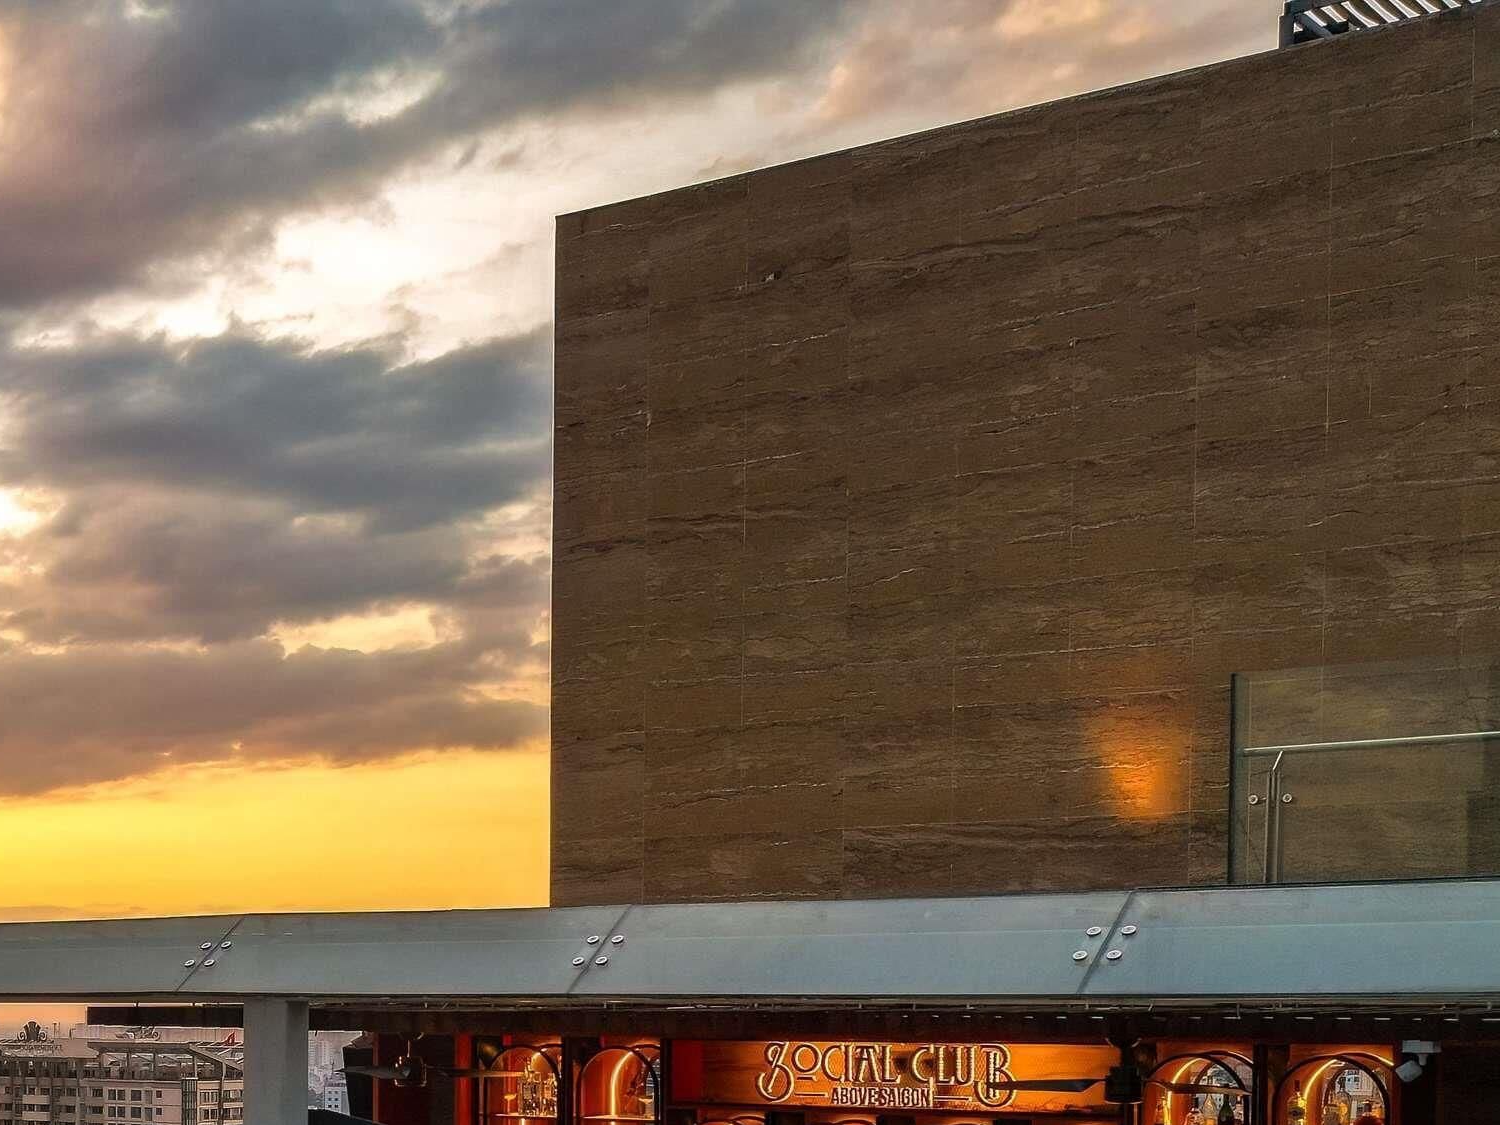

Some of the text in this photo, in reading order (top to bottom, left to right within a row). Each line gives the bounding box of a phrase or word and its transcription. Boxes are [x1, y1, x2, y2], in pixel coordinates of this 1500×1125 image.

[755, 1041, 1018, 1109] SOCIAL CLUB
[831, 1087, 931, 1107] ABOVE SAIGON
